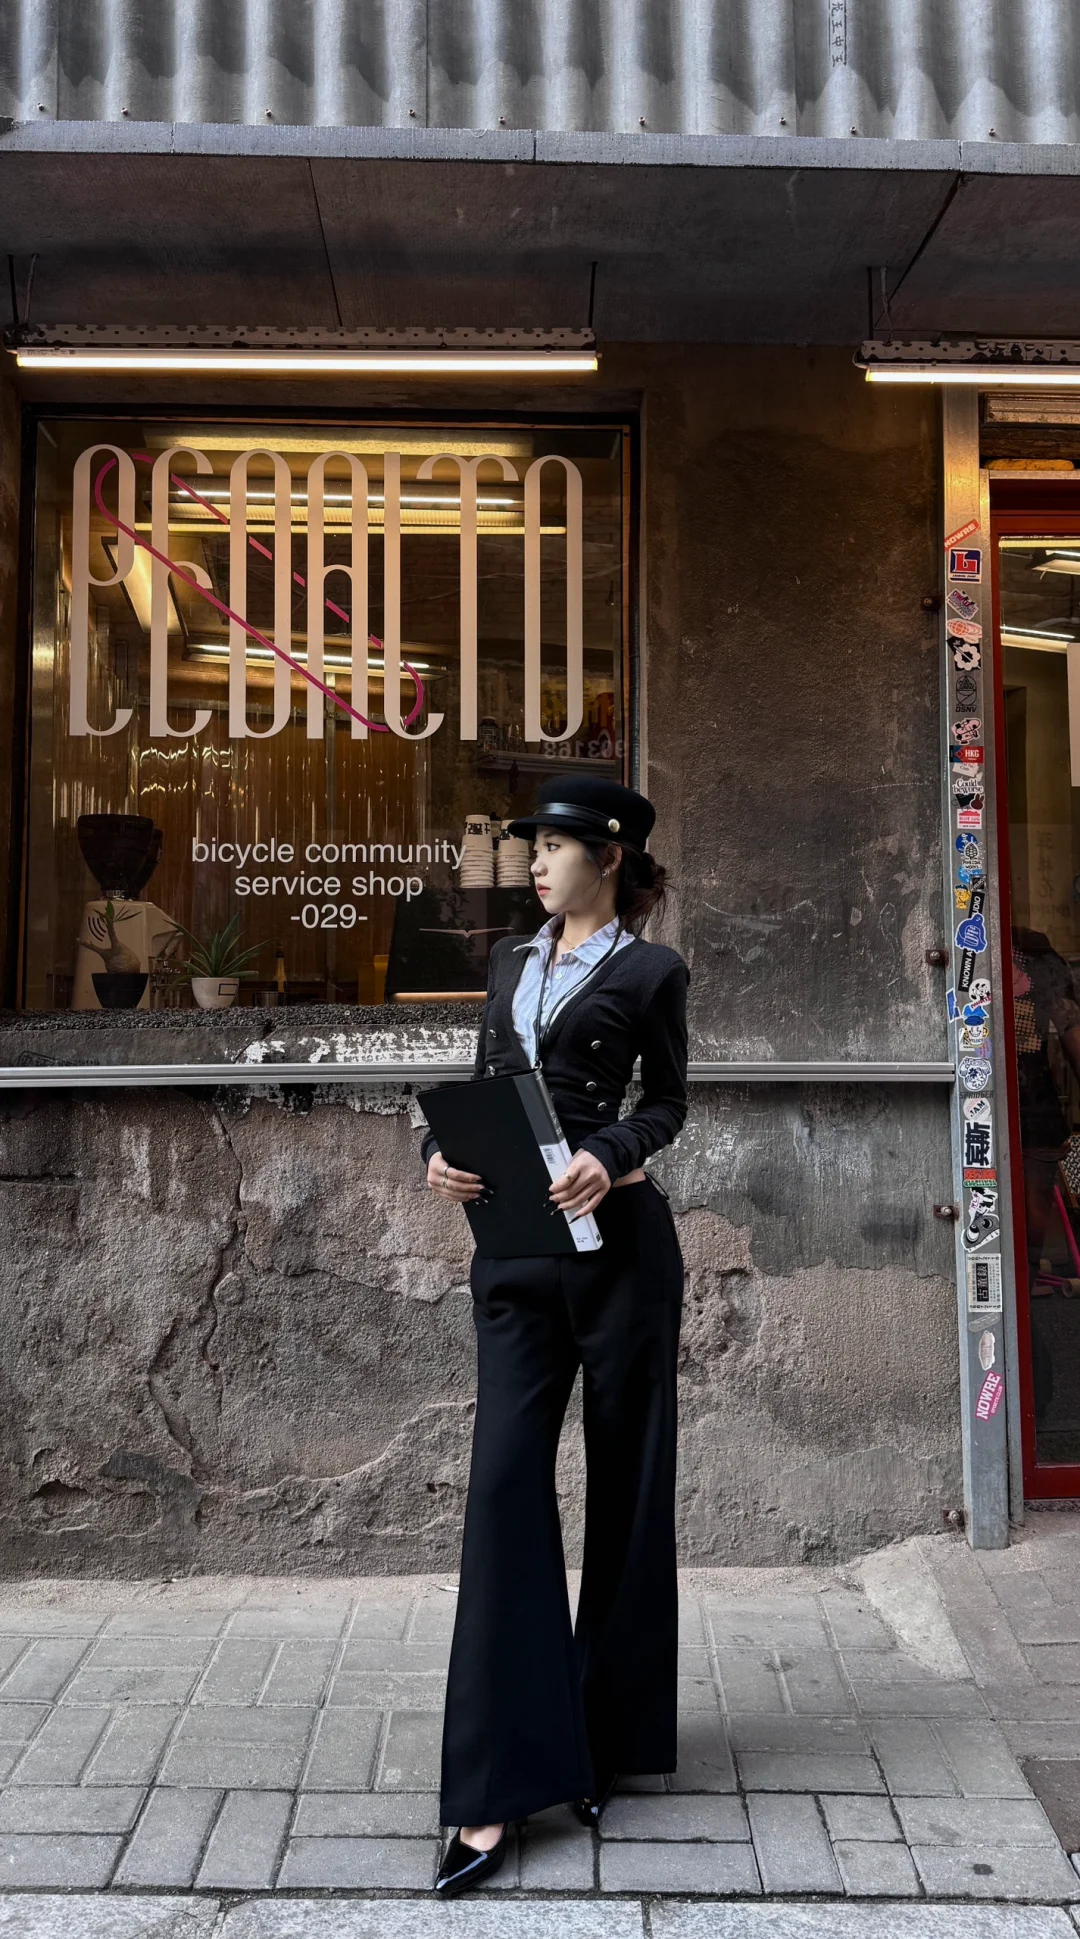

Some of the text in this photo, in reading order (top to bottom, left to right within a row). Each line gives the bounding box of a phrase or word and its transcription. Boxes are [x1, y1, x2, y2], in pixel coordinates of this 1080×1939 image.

[944, 521, 976, 548] NOWRE
[965, 749, 980, 758] HKG
[957, 778, 978, 787] Could
[191, 837, 468, 870] bicycle community
[234, 871, 424, 902] service shop
[290, 903, 368, 929] -029-
[962, 957, 973, 988] KNOWN
[969, 1099, 986, 1117] JAM
[976, 1372, 1001, 1420] NOWRE
